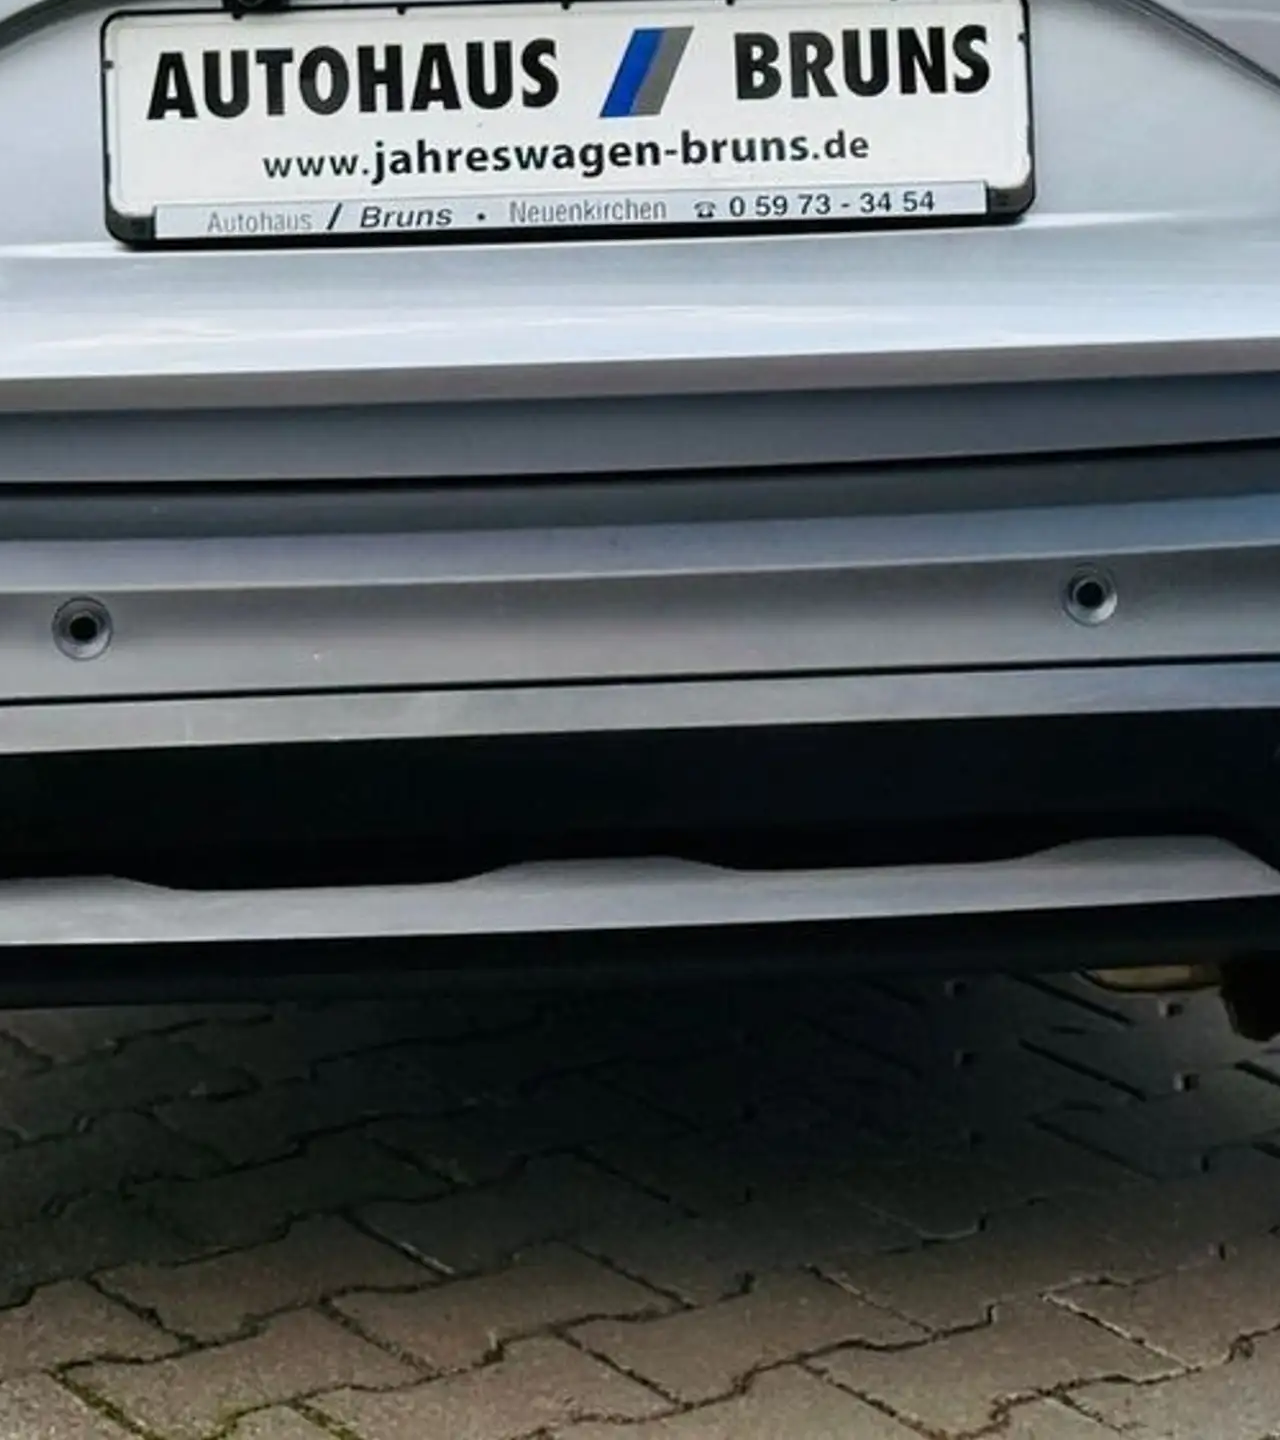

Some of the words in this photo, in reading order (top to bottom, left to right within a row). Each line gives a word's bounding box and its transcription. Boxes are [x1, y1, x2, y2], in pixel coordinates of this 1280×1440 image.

[147, 38, 559, 121] AUTOHAUS
[734, 24, 990, 100] BRUNS
[263, 130, 870, 186] www.jahreswagen-bruns.de
[206, 211, 313, 234] Autohaus
[359, 204, 454, 228] Bruns
[509, 198, 667, 225] Neuenkirchen
